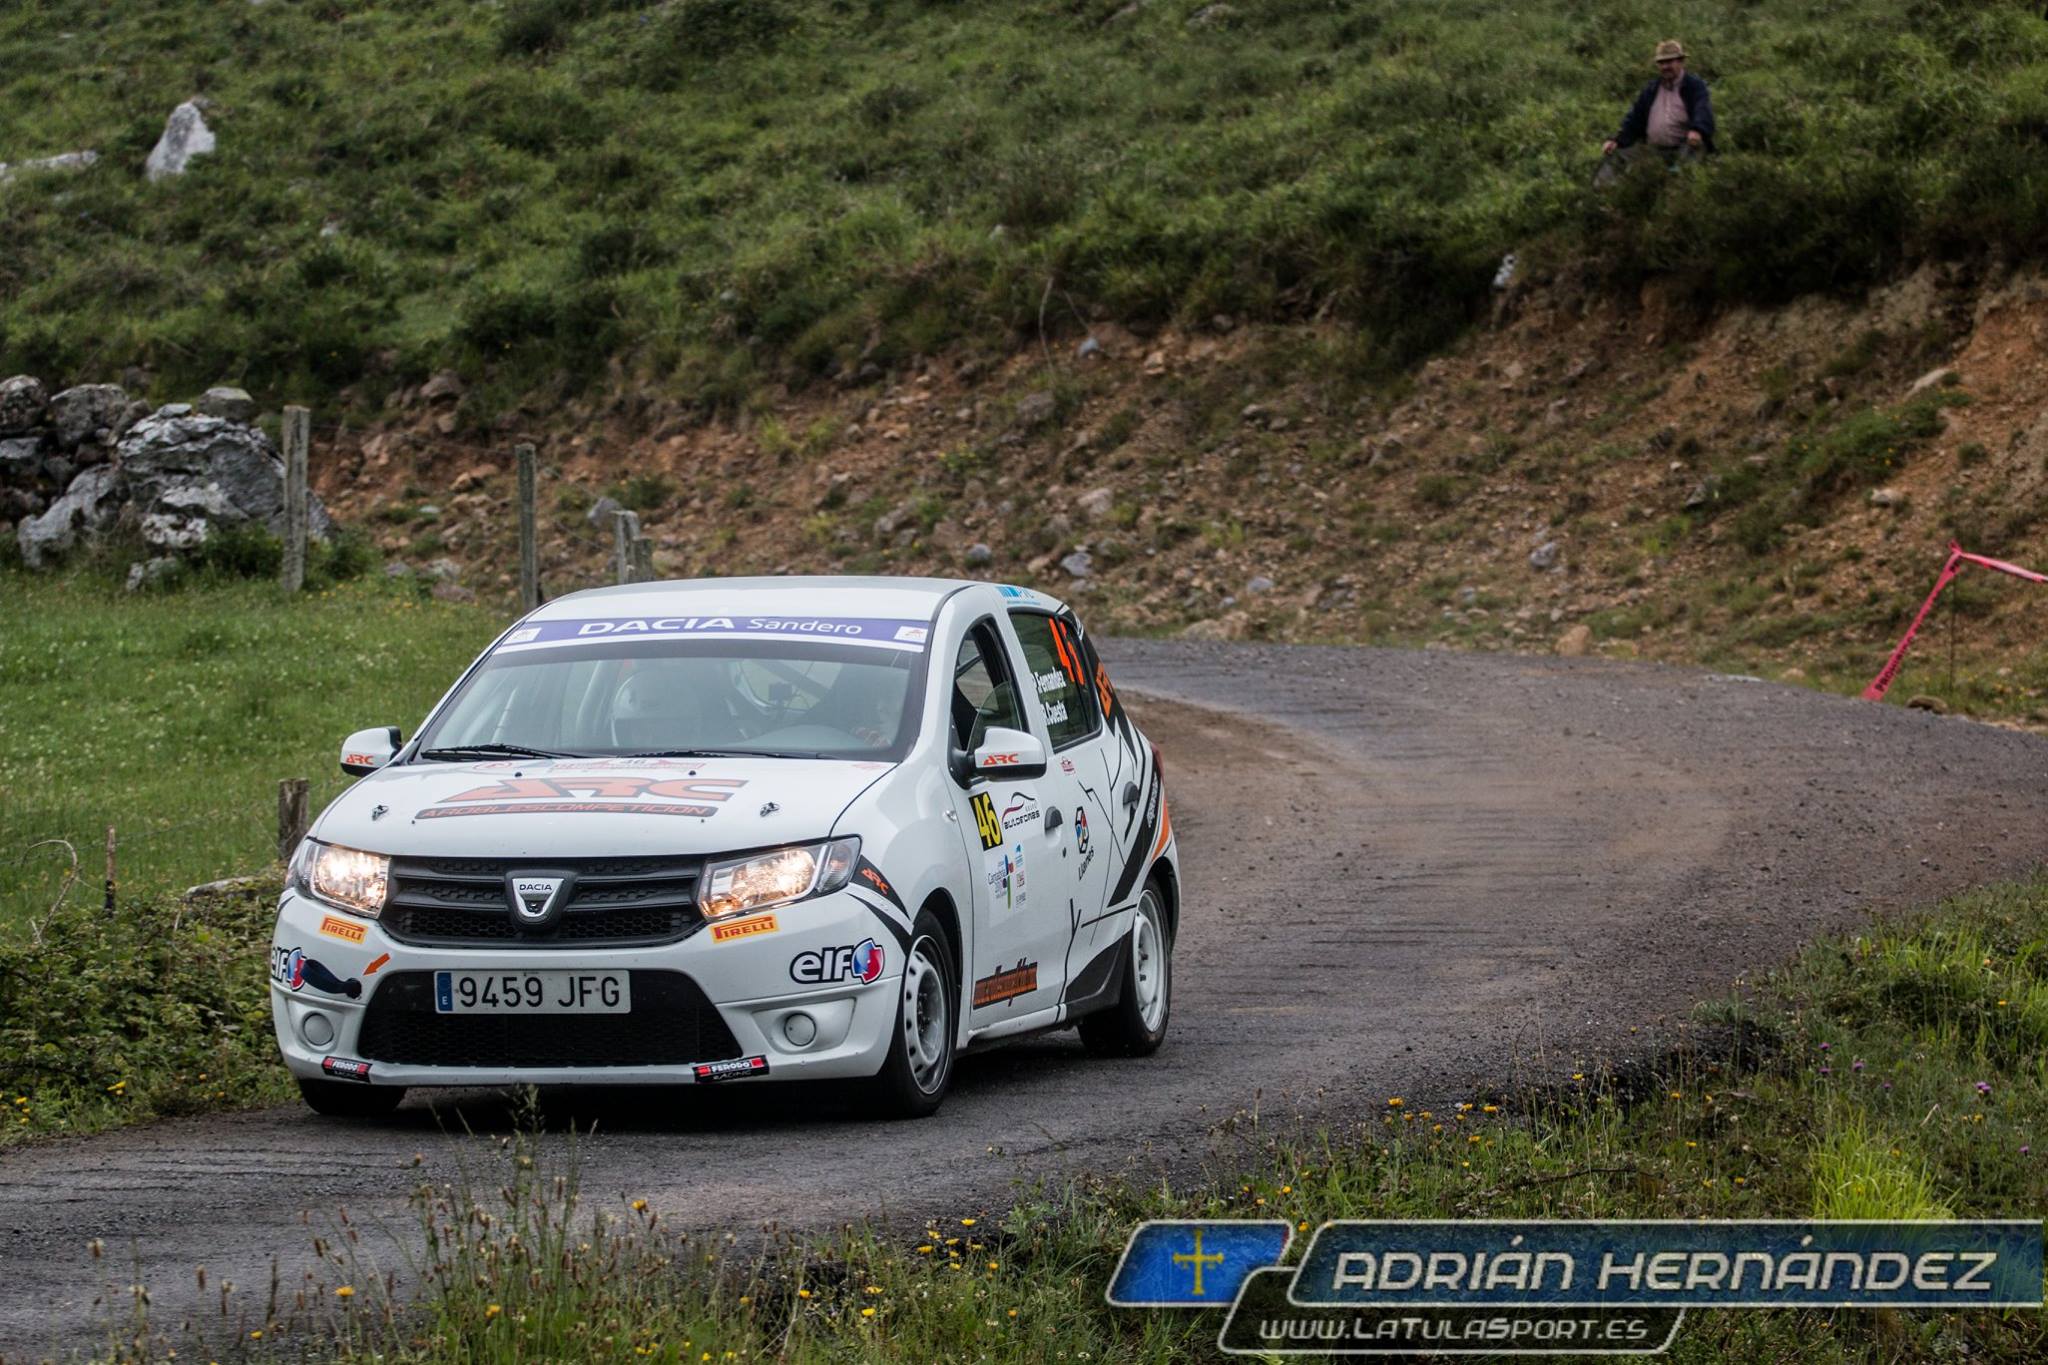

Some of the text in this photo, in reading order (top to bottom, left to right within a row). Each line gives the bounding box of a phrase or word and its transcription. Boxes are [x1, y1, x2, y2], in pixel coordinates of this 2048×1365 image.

[578, 618, 863, 635] DACIA Sandero
[346, 754, 374, 766] ARC
[983, 753, 1019, 766] ARC
[434, 776, 749, 803] ARC
[973, 793, 1001, 847] 46
[519, 883, 552, 891] DACIA
[321, 917, 365, 940] PIRELLI
[714, 916, 775, 940] PIRELLI
[790, 945, 854, 984] elf
[442, 996, 448, 1005] E
[459, 976, 620, 1008] 9459 JFG
[711, 1062, 750, 1073] FERODO
